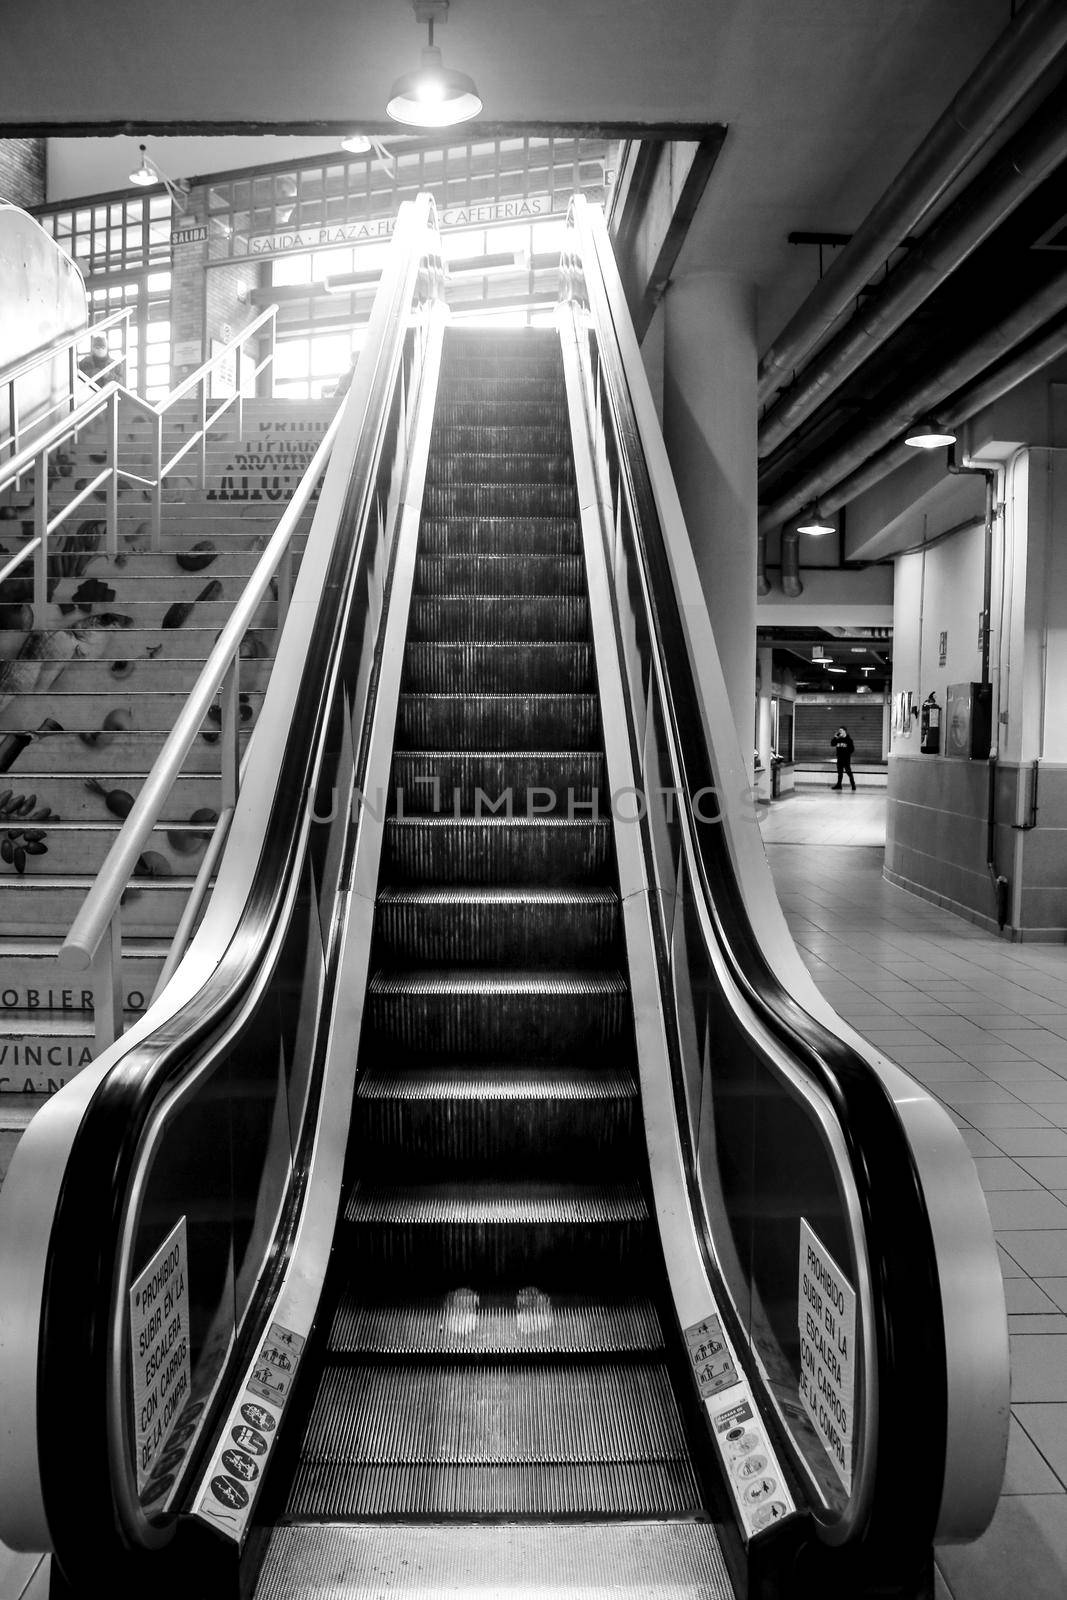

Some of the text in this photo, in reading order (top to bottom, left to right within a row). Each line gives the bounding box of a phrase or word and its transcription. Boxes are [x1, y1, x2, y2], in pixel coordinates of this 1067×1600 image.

[172, 229, 206, 244] SALIDA
[252, 234, 304, 254] SALIDA
[318, 224, 370, 244] PLAZA
[442, 199, 542, 225] CAFETERIAS
[139, 1272, 185, 1358] SUBIR EN LA
[142, 1243, 181, 1315] PROHIBIDO
[802, 1273, 848, 1361] SUBIR EN LA
[807, 1243, 845, 1317] PROHIBIDO
[141, 1336, 187, 1432] CON CARROS
[145, 1312, 182, 1387] ESCALERA
[801, 1337, 847, 1434] CON CARROS
[806, 1311, 842, 1389] ESCALERA
[142, 1369, 188, 1471] DE LA COMPRA
[800, 1366, 846, 1471] DE LA COMPRA
